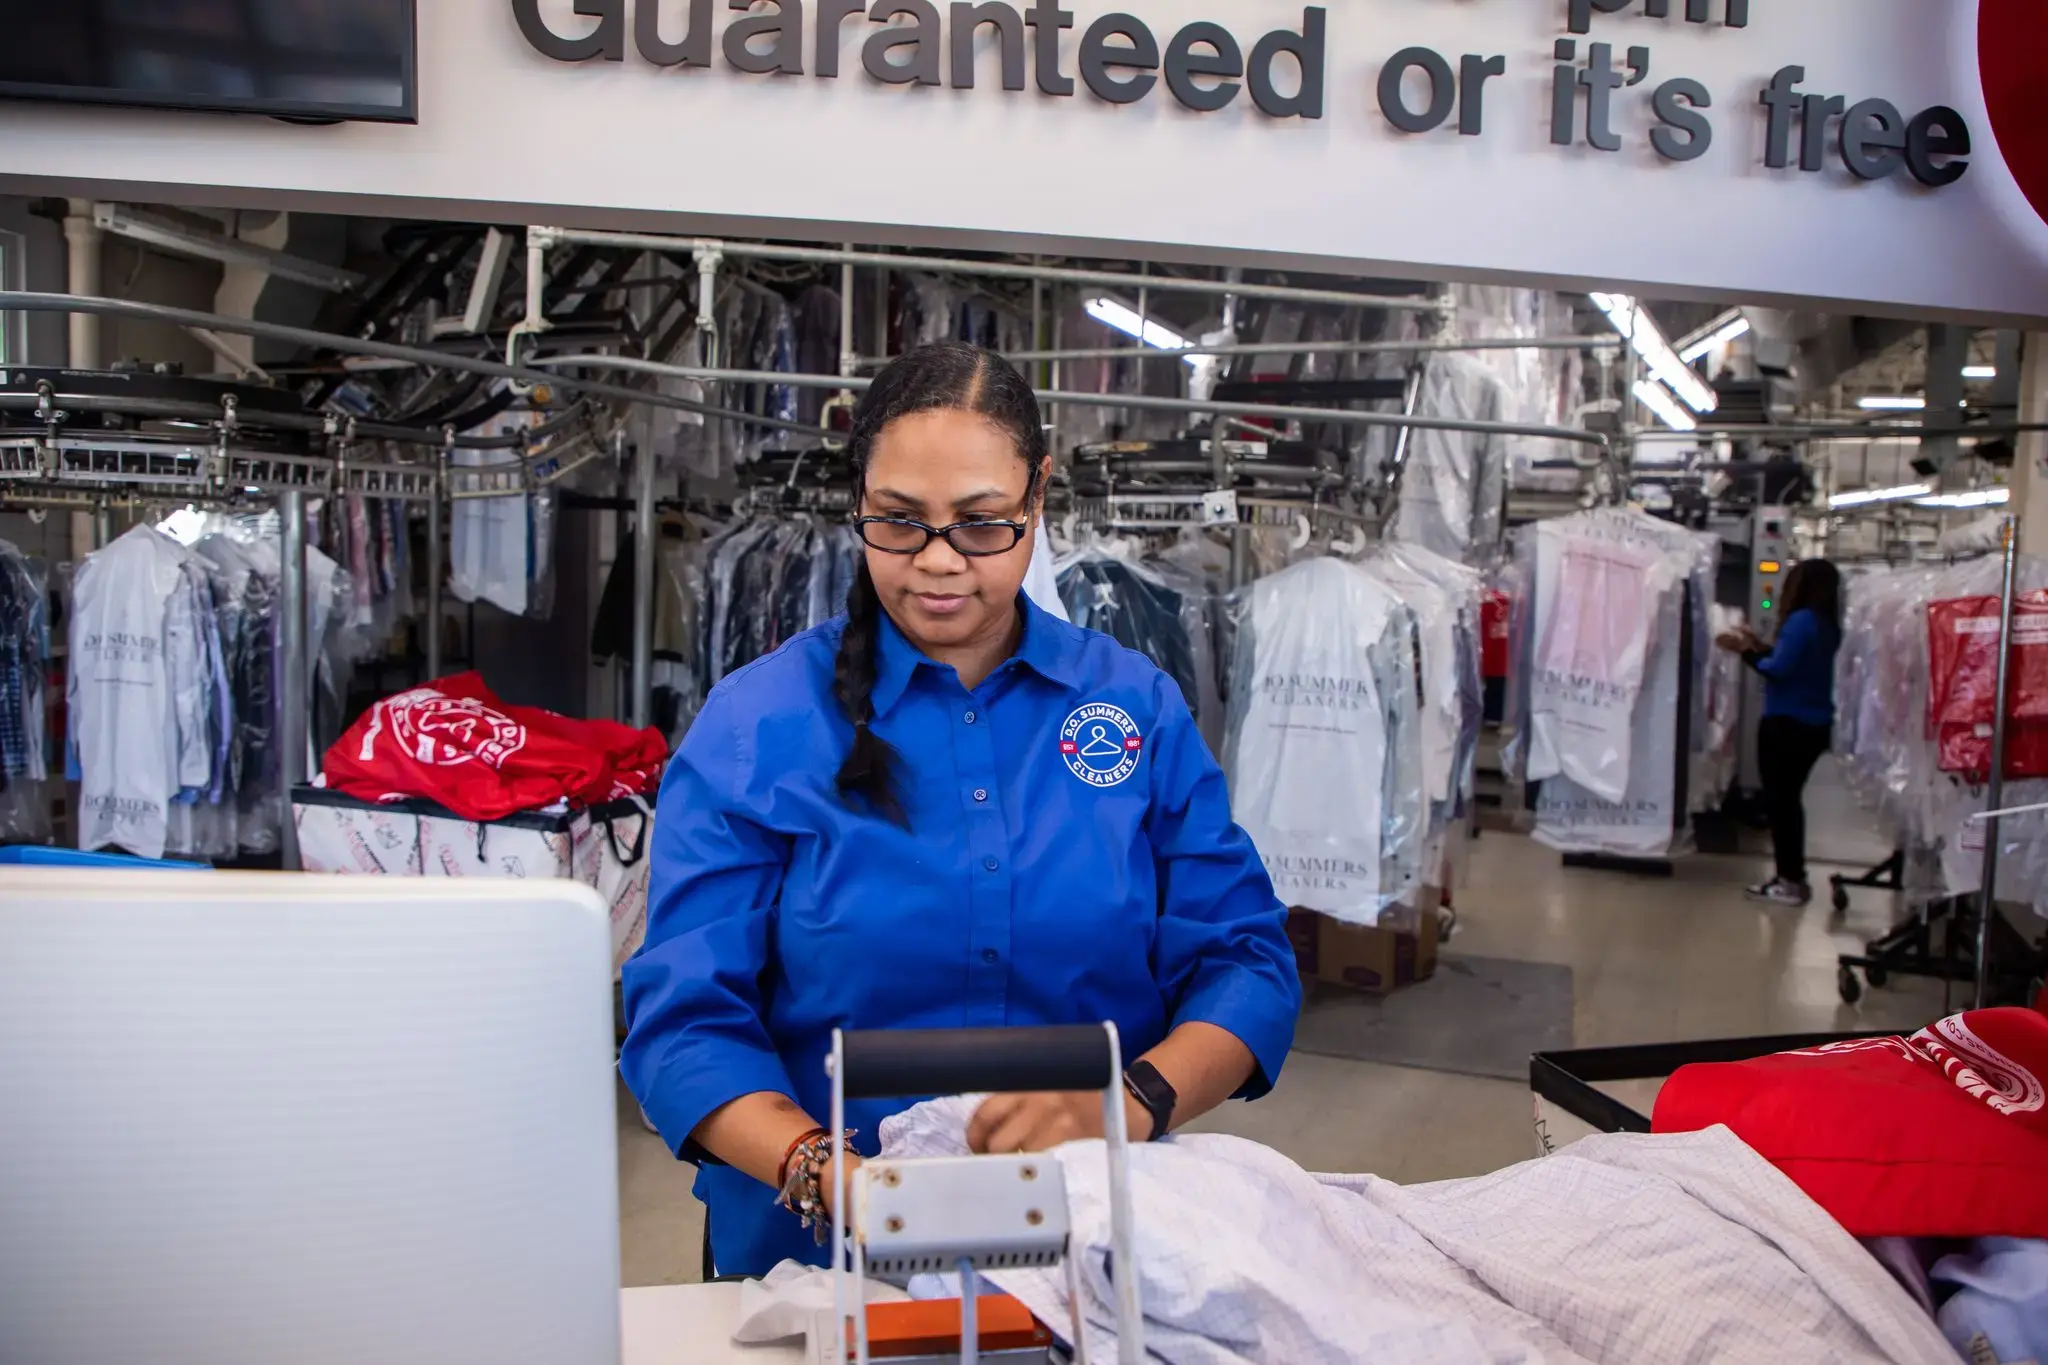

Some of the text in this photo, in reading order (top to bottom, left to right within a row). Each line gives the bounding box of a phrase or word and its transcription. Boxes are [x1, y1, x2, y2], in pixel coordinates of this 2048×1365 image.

[512, 0, 1326, 119] Guaranteed
[1377, 46, 1505, 135] or
[1760, 65, 1971, 187] free
[1289, 673, 1368, 695] SUMMER
[1080, 706, 1134, 734] SUMMERS
[1073, 758, 1133, 784] CLEANERS
[1272, 871, 1348, 890] LEANERS
